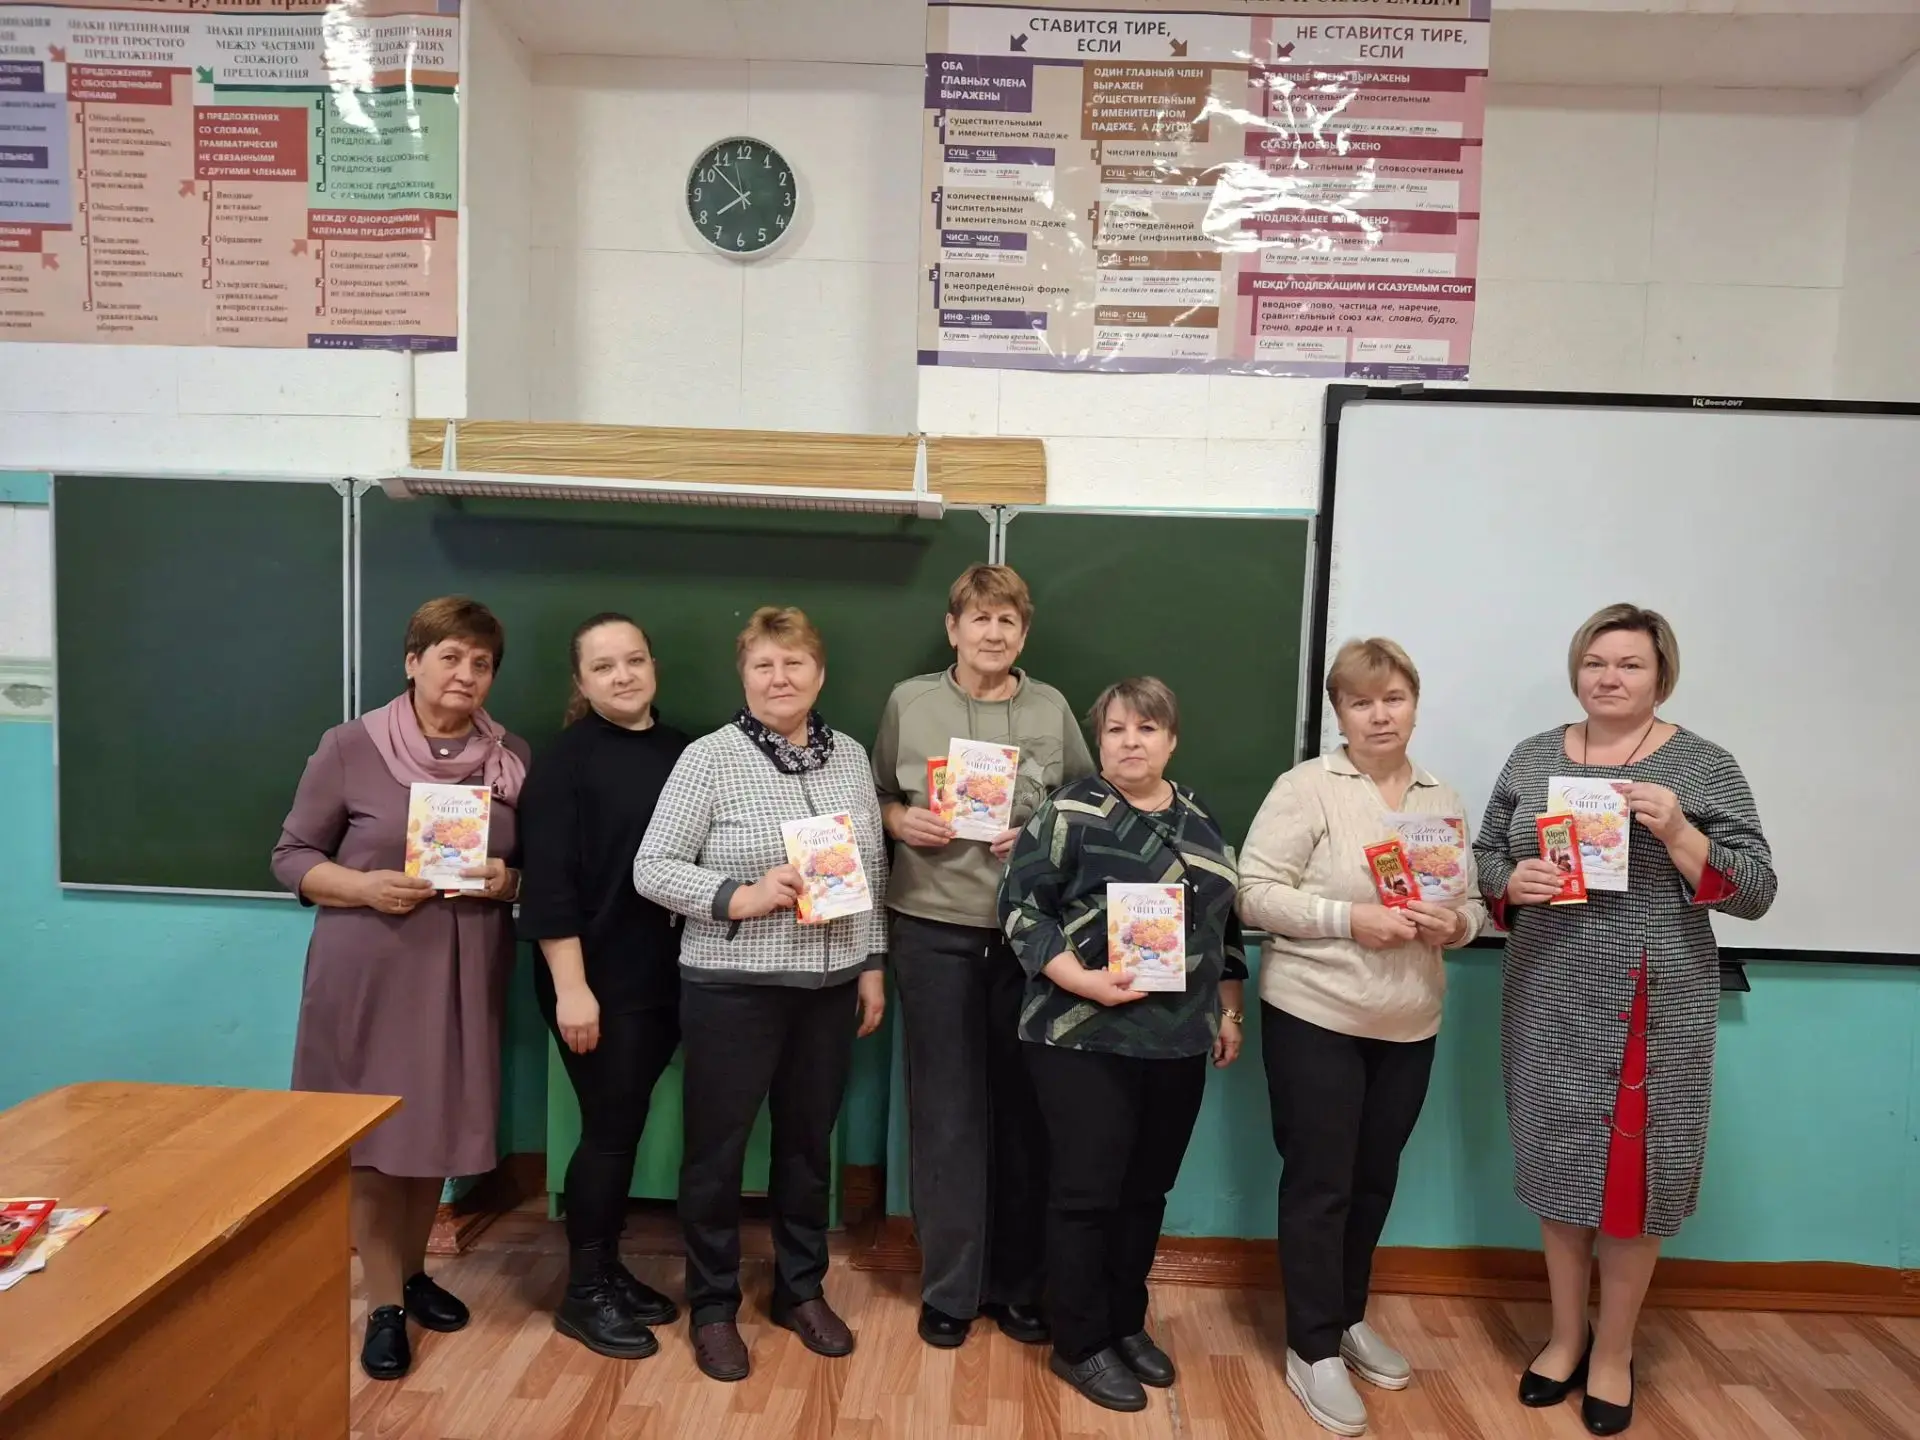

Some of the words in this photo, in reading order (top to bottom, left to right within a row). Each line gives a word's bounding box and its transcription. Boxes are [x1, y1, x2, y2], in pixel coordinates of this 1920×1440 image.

[206, 26, 244, 36] ЗНАКИ
[1028, 18, 1118, 34] СТАВИТСЯ
[1124, 20, 1172, 38] ТИРЕ,
[1296, 26, 1318, 40] НЕ
[1324, 26, 1414, 41] СТАВИТСЯ
[1420, 28, 1468, 44] ТИРЕ,
[122, 38, 186, 48] ПРОСТОГО
[216, 40, 256, 50] МЕЖДУ
[261, 41, 316, 50] ЧАСТЯМИ
[1077, 38, 1122, 52] ЕСЛИ
[84, 49, 174, 62] ПРЕДЛОЖЕНИЯ
[1360, 44, 1404, 59] ЕСЛИ
[234, 54, 298, 64] СЛОЖНОГО
[941, 61, 964, 72] ОБА
[224, 68, 309, 78] ПРЕДЛОЖЕНИЯ
[1094, 68, 1124, 78] ОДИН
[1126, 66, 1175, 78] ГЛАВНЫЙ
[1176, 68, 1204, 78] ЧЛЕН
[941, 76, 990, 88] ГЛАВНЫХ
[992, 78, 1027, 88] ЧЛЕНА
[1094, 81, 1144, 91] ВЫРАЖЕН
[940, 90, 1000, 102] ВЫРАЖЕНЫ
[1092, 94, 1196, 106] СУЩЕСТВИТЕЛЬНЫМ
[198, 112, 204, 120] В
[206, 112, 280, 121] ПРЕДЛОЖЕНИЯХ
[1092, 109, 1098, 118] В
[950, 118, 1042, 127] существительными
[198, 126, 212, 134] СО
[1092, 123, 1136, 133] ПАДЕЖЕ,
[1141, 123, 1149, 132] А
[199, 140, 278, 148] ГРАММАТИЧЕСКИ
[1260, 140, 1325, 150] СКАЗУЕМОЕ
[736, 145, 752, 160] 12
[1106, 150, 1178, 158] числительным
[212, 154, 275, 162] СВЯЗАННЫМИ
[330, 154, 374, 163] СЛОЖНОЕ
[376, 154, 430, 163] БЕССОЮЗНОЕ
[714, 152, 731, 166] 11
[763, 154, 772, 168] 1
[199, 167, 206, 175] С
[208, 167, 250, 176] ДРУГИМИ
[252, 168, 297, 176] ЧЛЕНАМИ
[330, 166, 392, 174] ПРЕДЛОЖЕНИЕ
[1378, 165, 1464, 175] словосочетанием
[698, 168, 716, 183] 10
[778, 172, 787, 186] 2
[330, 182, 373, 190] СЛОЖНОЕ
[376, 182, 435, 190] ПРЕДЛОЖЕНИЕ
[423, 192, 452, 200] СВЯЗИ
[693, 188, 702, 202] 9
[784, 192, 791, 206] 3
[946, 205, 1024, 214] числительными
[312, 214, 348, 223] МЕЖДУ
[350, 214, 420, 224] ОДНОРОДНЫМИ
[700, 210, 708, 224] 8
[776, 214, 785, 228] 4
[954, 217, 1027, 226] именительном
[1256, 214, 1328, 224] ПОДЛЕЖАЩЕЕ
[312, 226, 358, 236] ЧЛЕНАМИ
[360, 227, 425, 237] ПРЕДЛОЖЕНИЯ
[714, 225, 722, 240] 7
[758, 228, 767, 242] 5
[736, 232, 745, 247] 6
[944, 270, 995, 279] глаголами
[952, 283, 1034, 292] неопределённой
[1036, 285, 1070, 294] форме
[1253, 280, 1290, 290] МЕЖДУ
[1291, 280, 1366, 292] ПОДЛЕЖАЩИМ
[1368, 283, 1376, 291] И
[1377, 283, 1440, 293] СКАЗУЕМЫМ
[1442, 284, 1472, 294] СТОИТ
[944, 294, 1025, 305] (инфинитивами)
[1262, 302, 1302, 310] вводное
[1381, 304, 1395, 312] не,
[1398, 304, 1441, 313] наречие,
[1338, 314, 1362, 322] союз
[1365, 314, 1384, 322] как,
[1388, 315, 1424, 324] словно,
[1428, 315, 1459, 326] будто,
[1262, 324, 1291, 332] точно,
[1294, 324, 1324, 333] вроде
[1546, 830, 1568, 838] Alpen
[1548, 836, 1567, 845] Gold
[1376, 858, 1398, 867] Alpen
[1380, 863, 1399, 873] Gold
